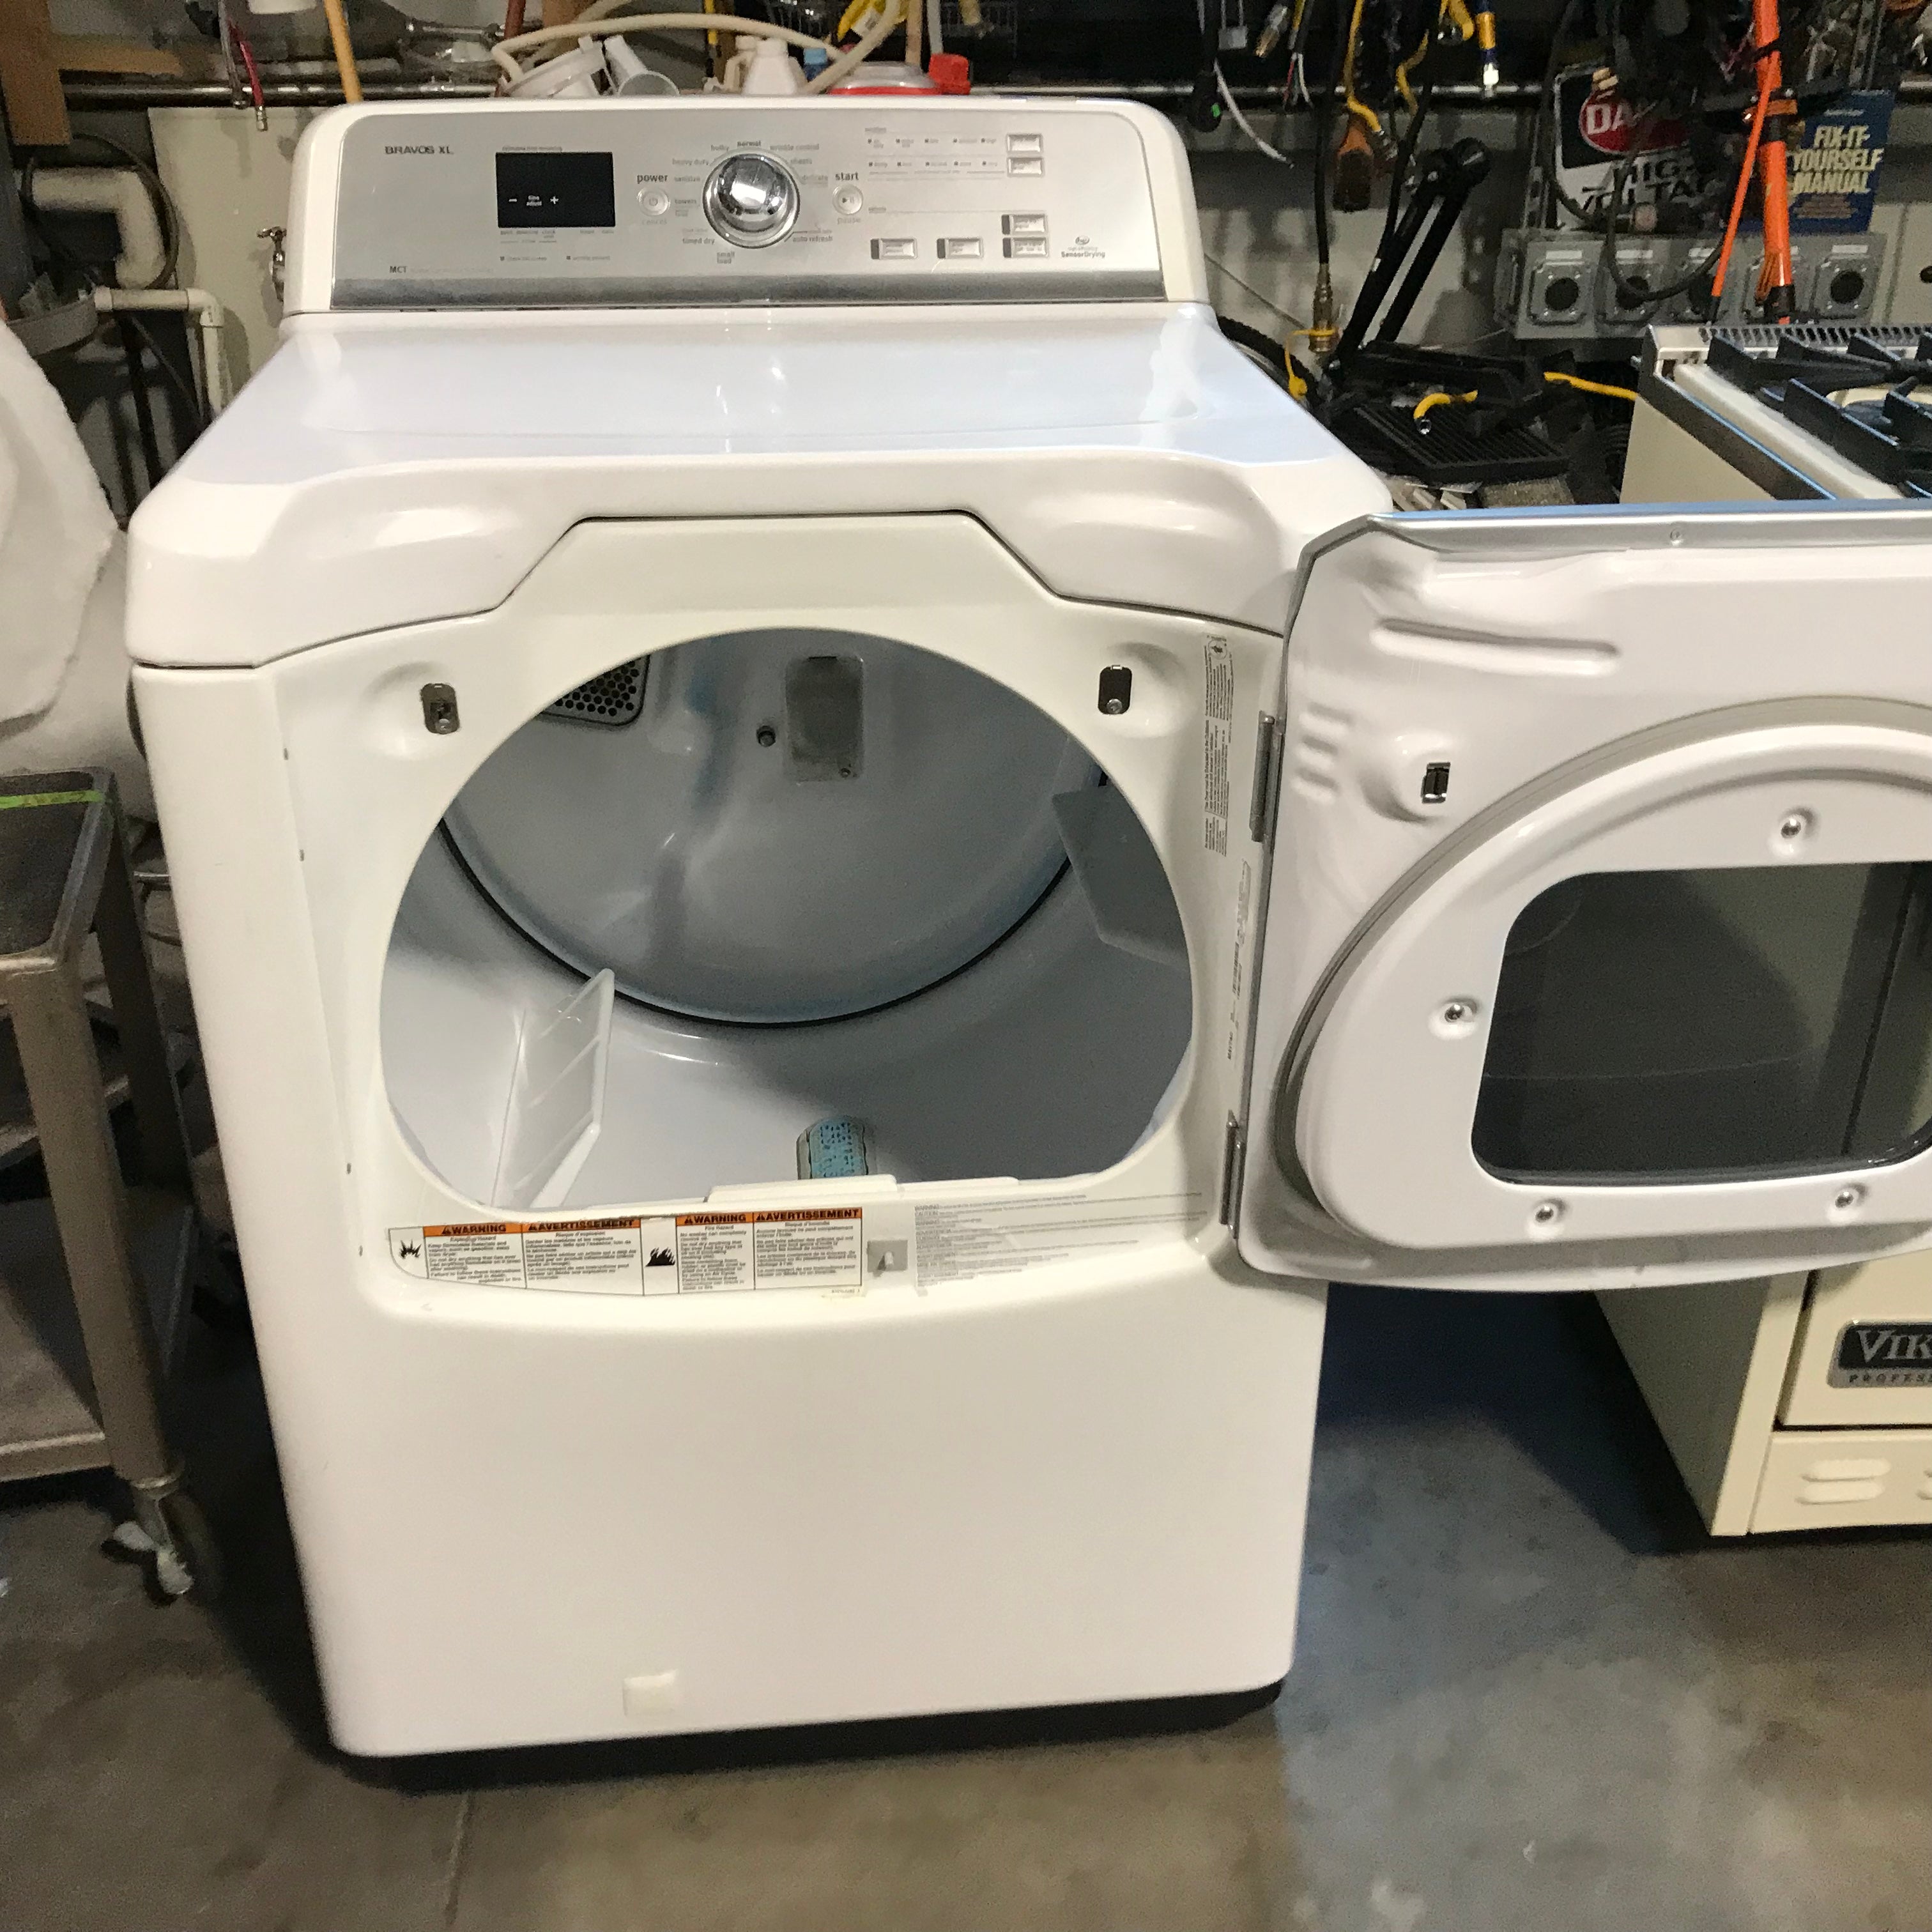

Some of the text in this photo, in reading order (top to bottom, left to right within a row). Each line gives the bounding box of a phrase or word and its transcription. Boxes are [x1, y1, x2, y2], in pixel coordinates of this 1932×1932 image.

[1814, 125, 1870, 148] FIX-IT
[385, 146, 454, 155] BRAVOS XL
[1793, 148, 1884, 171] YOURSELF
[637, 174, 668, 184] power
[835, 171, 859, 182] start
[1793, 172, 1871, 194] MANUAL
[694, 1214, 746, 1223] WARNING
[766, 1209, 859, 1221] AVERTISSEMENT
[452, 1224, 506, 1234] WARNING
[538, 1220, 634, 1230] AVERTISSEMENT
